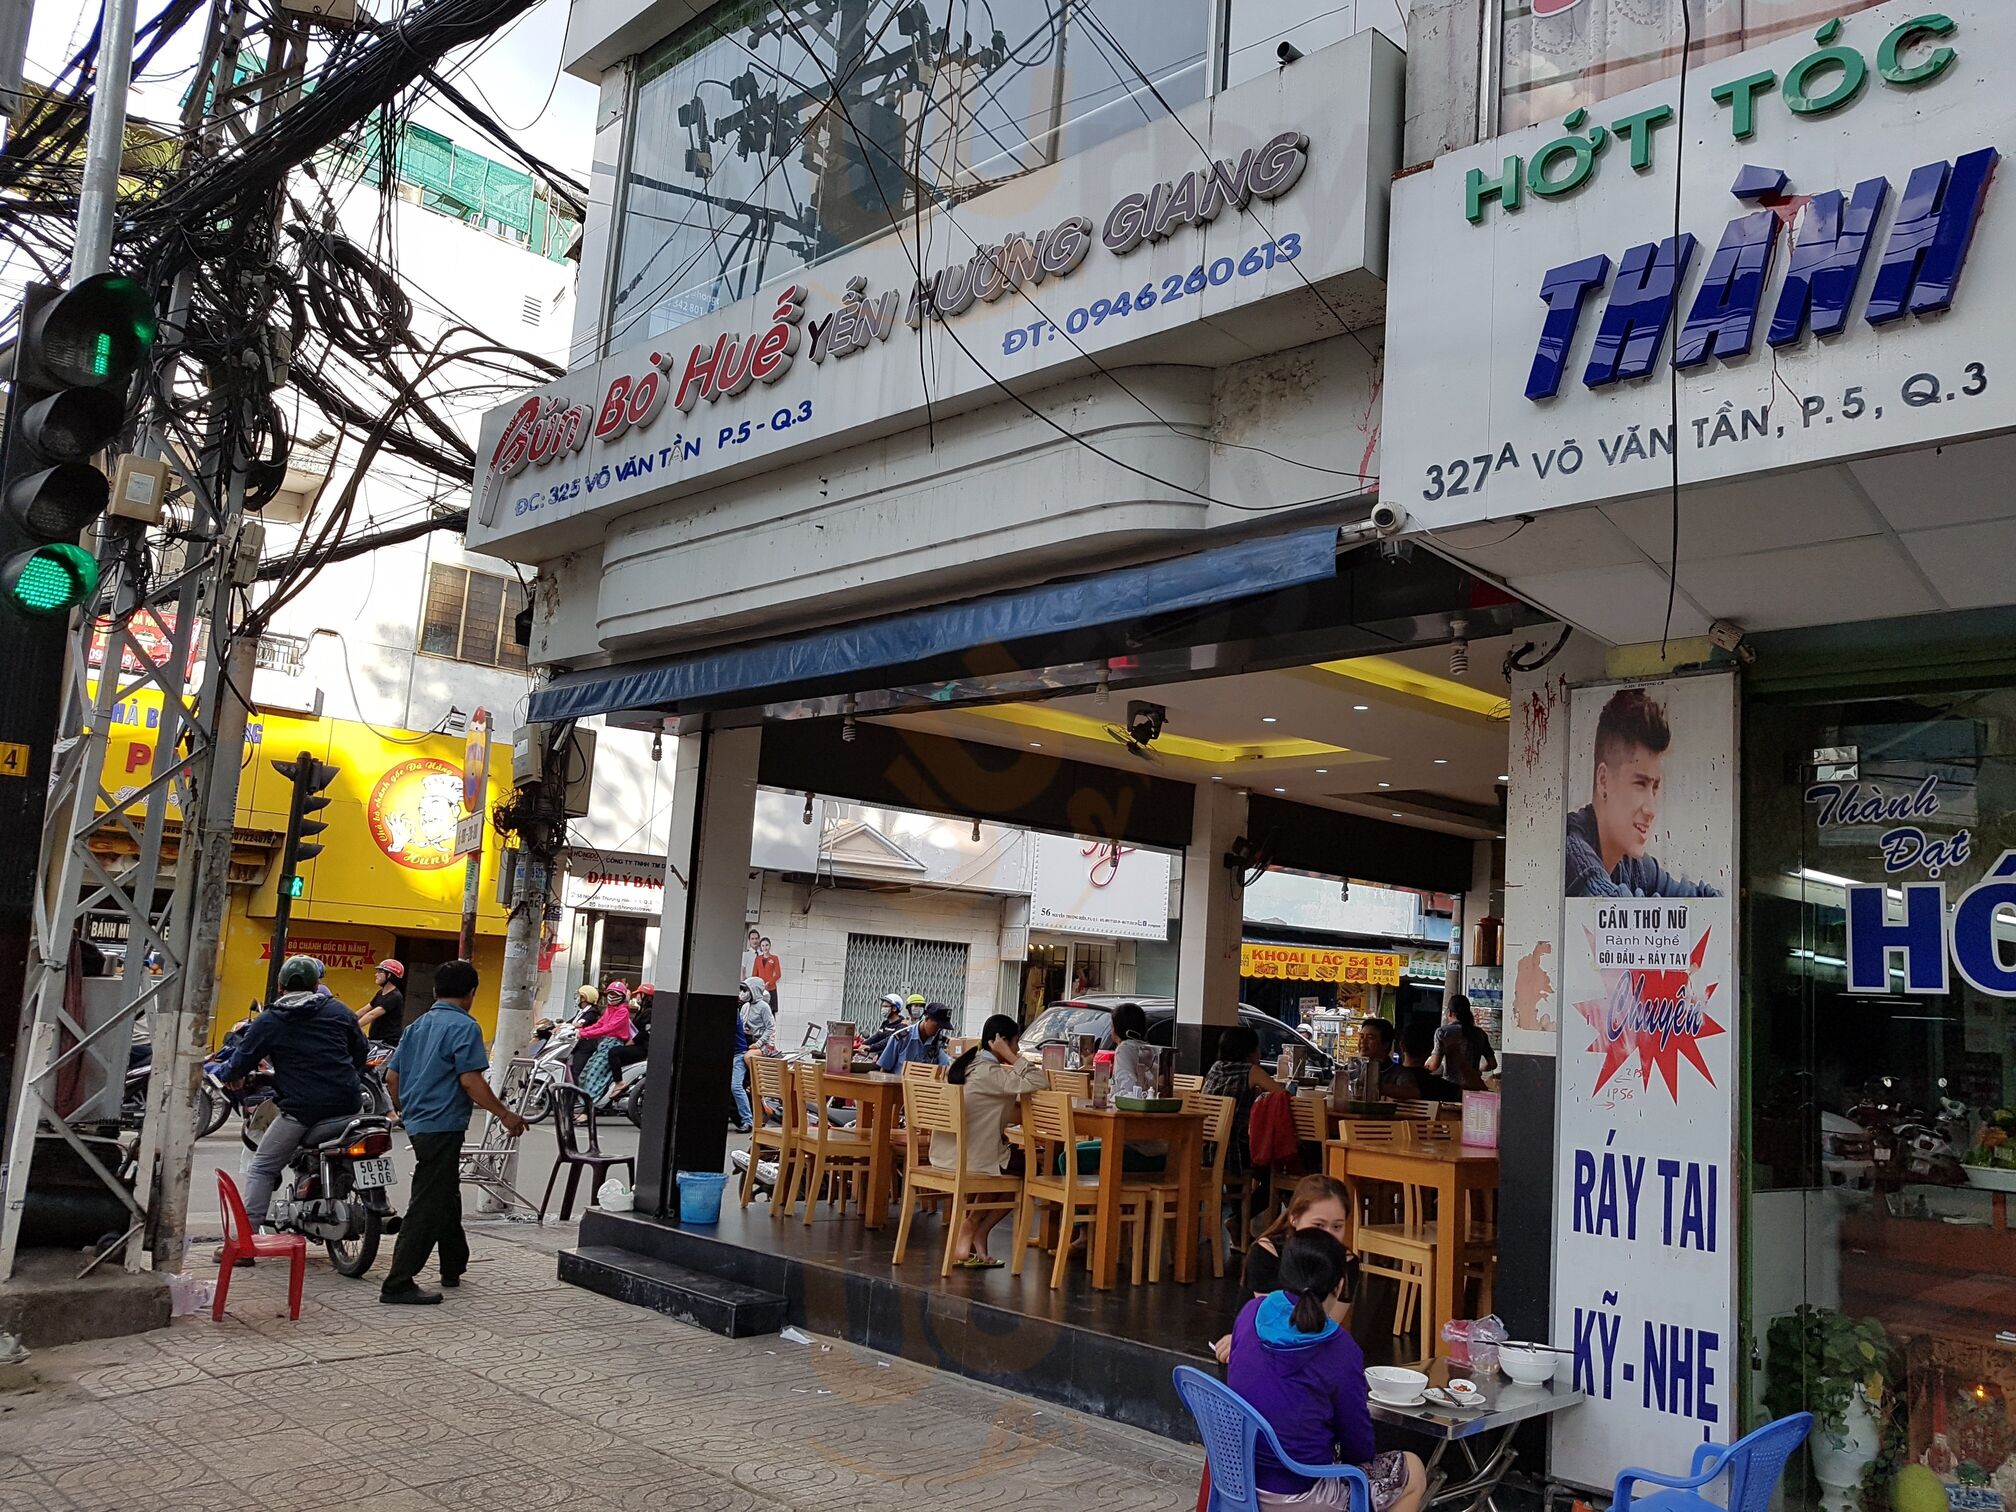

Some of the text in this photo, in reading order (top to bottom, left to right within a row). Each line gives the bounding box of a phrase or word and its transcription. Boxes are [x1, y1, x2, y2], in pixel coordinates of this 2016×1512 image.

[1465, 13, 1959, 224] HỚT TÓC
[594, 350, 672, 442] Bò
[674, 284, 808, 413] Huế
[1101, 130, 1310, 257] GIANG
[1523, 147, 1999, 401] THÀNH
[1002, 319, 1055, 356] ĐT:
[1531, 439, 1583, 479] VÕ
[1598, 422, 1674, 467] VĂN
[1901, 362, 1988, 407] Q.3
[515, 495, 545, 517] ĐC:
[548, 481, 581, 506] 325
[584, 465, 611, 494] VÕ
[615, 454, 654, 482] VĂN
[658, 433, 702, 468] TẦN
[717, 420, 751, 450] P.5
[770, 400, 814, 432] Q.3
[1804, 775, 1940, 827] Thành
[1880, 826, 1971, 878] Đạt
[91, 917, 116, 939] BÁNH
[1041, 907, 1051, 916] 56
[1598, 904, 1689, 933] CẦN THỢ NỮ
[1251, 949, 1305, 963] KHOAI
[1348, 956, 1369, 968] 54
[1374, 955, 1393, 967] 54
[1599, 951, 1614, 967] GỘI
[1616, 948, 1635, 965] ĐẦU
[1648, 950, 1666, 965] RÁY
[1670, 952, 1688, 966] TAY
[1605, 933, 1680, 948] Rành Nghề
[1606, 970, 1704, 1052] Chuyên
[1572, 1128, 1718, 1253] RÁY TAI
